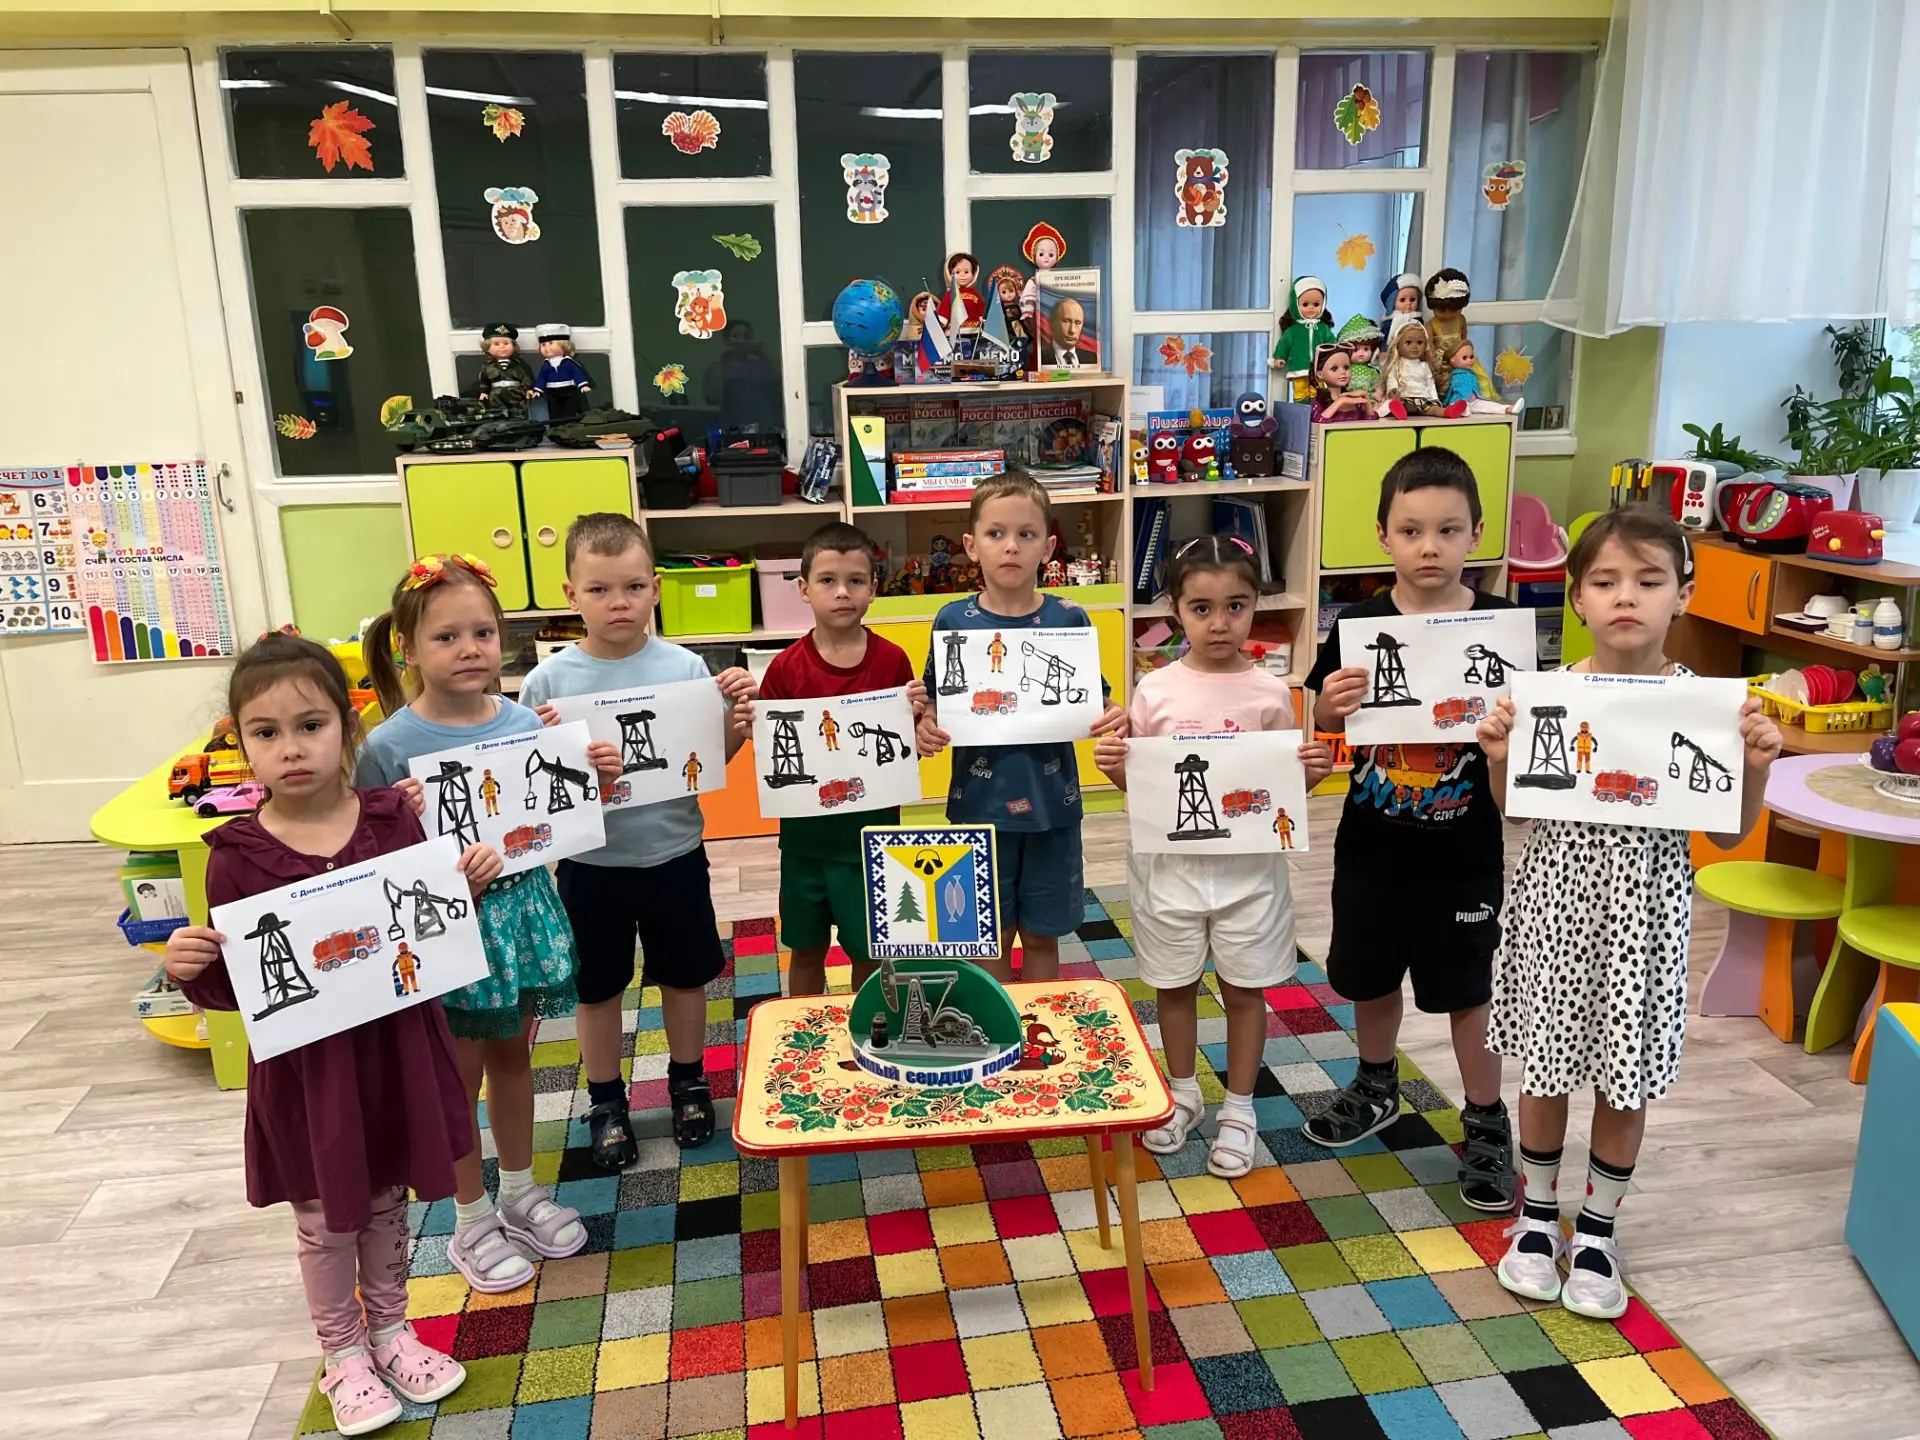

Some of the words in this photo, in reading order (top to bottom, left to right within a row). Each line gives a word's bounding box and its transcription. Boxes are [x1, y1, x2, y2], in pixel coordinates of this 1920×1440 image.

[0, 471, 27, 480] ЧЕТ
[31, 471, 48, 480] ДО
[33, 493, 47, 508] 6
[38, 522, 50, 536] 7
[43, 550, 56, 565] 8
[128, 547, 133, 555] 1
[136, 548, 148, 556] ДО
[150, 546, 164, 555] 20
[118, 556, 152, 564] СОСТАВ
[154, 554, 184, 562] ЧИСЛА
[48, 578, 61, 592] 9
[51, 606, 71, 620] 10
[1433, 809, 1455, 821] GIVE
[1456, 806, 1469, 816] UP
[300, 885, 324, 898] Днем
[326, 869, 377, 887] нефтяника!
[1455, 910, 1490, 923] PUMA
[872, 943, 998, 958] НИЖНЕВАРТОВСК
[905, 1067, 974, 1087] сердцу
[982, 1047, 1020, 1077] город
